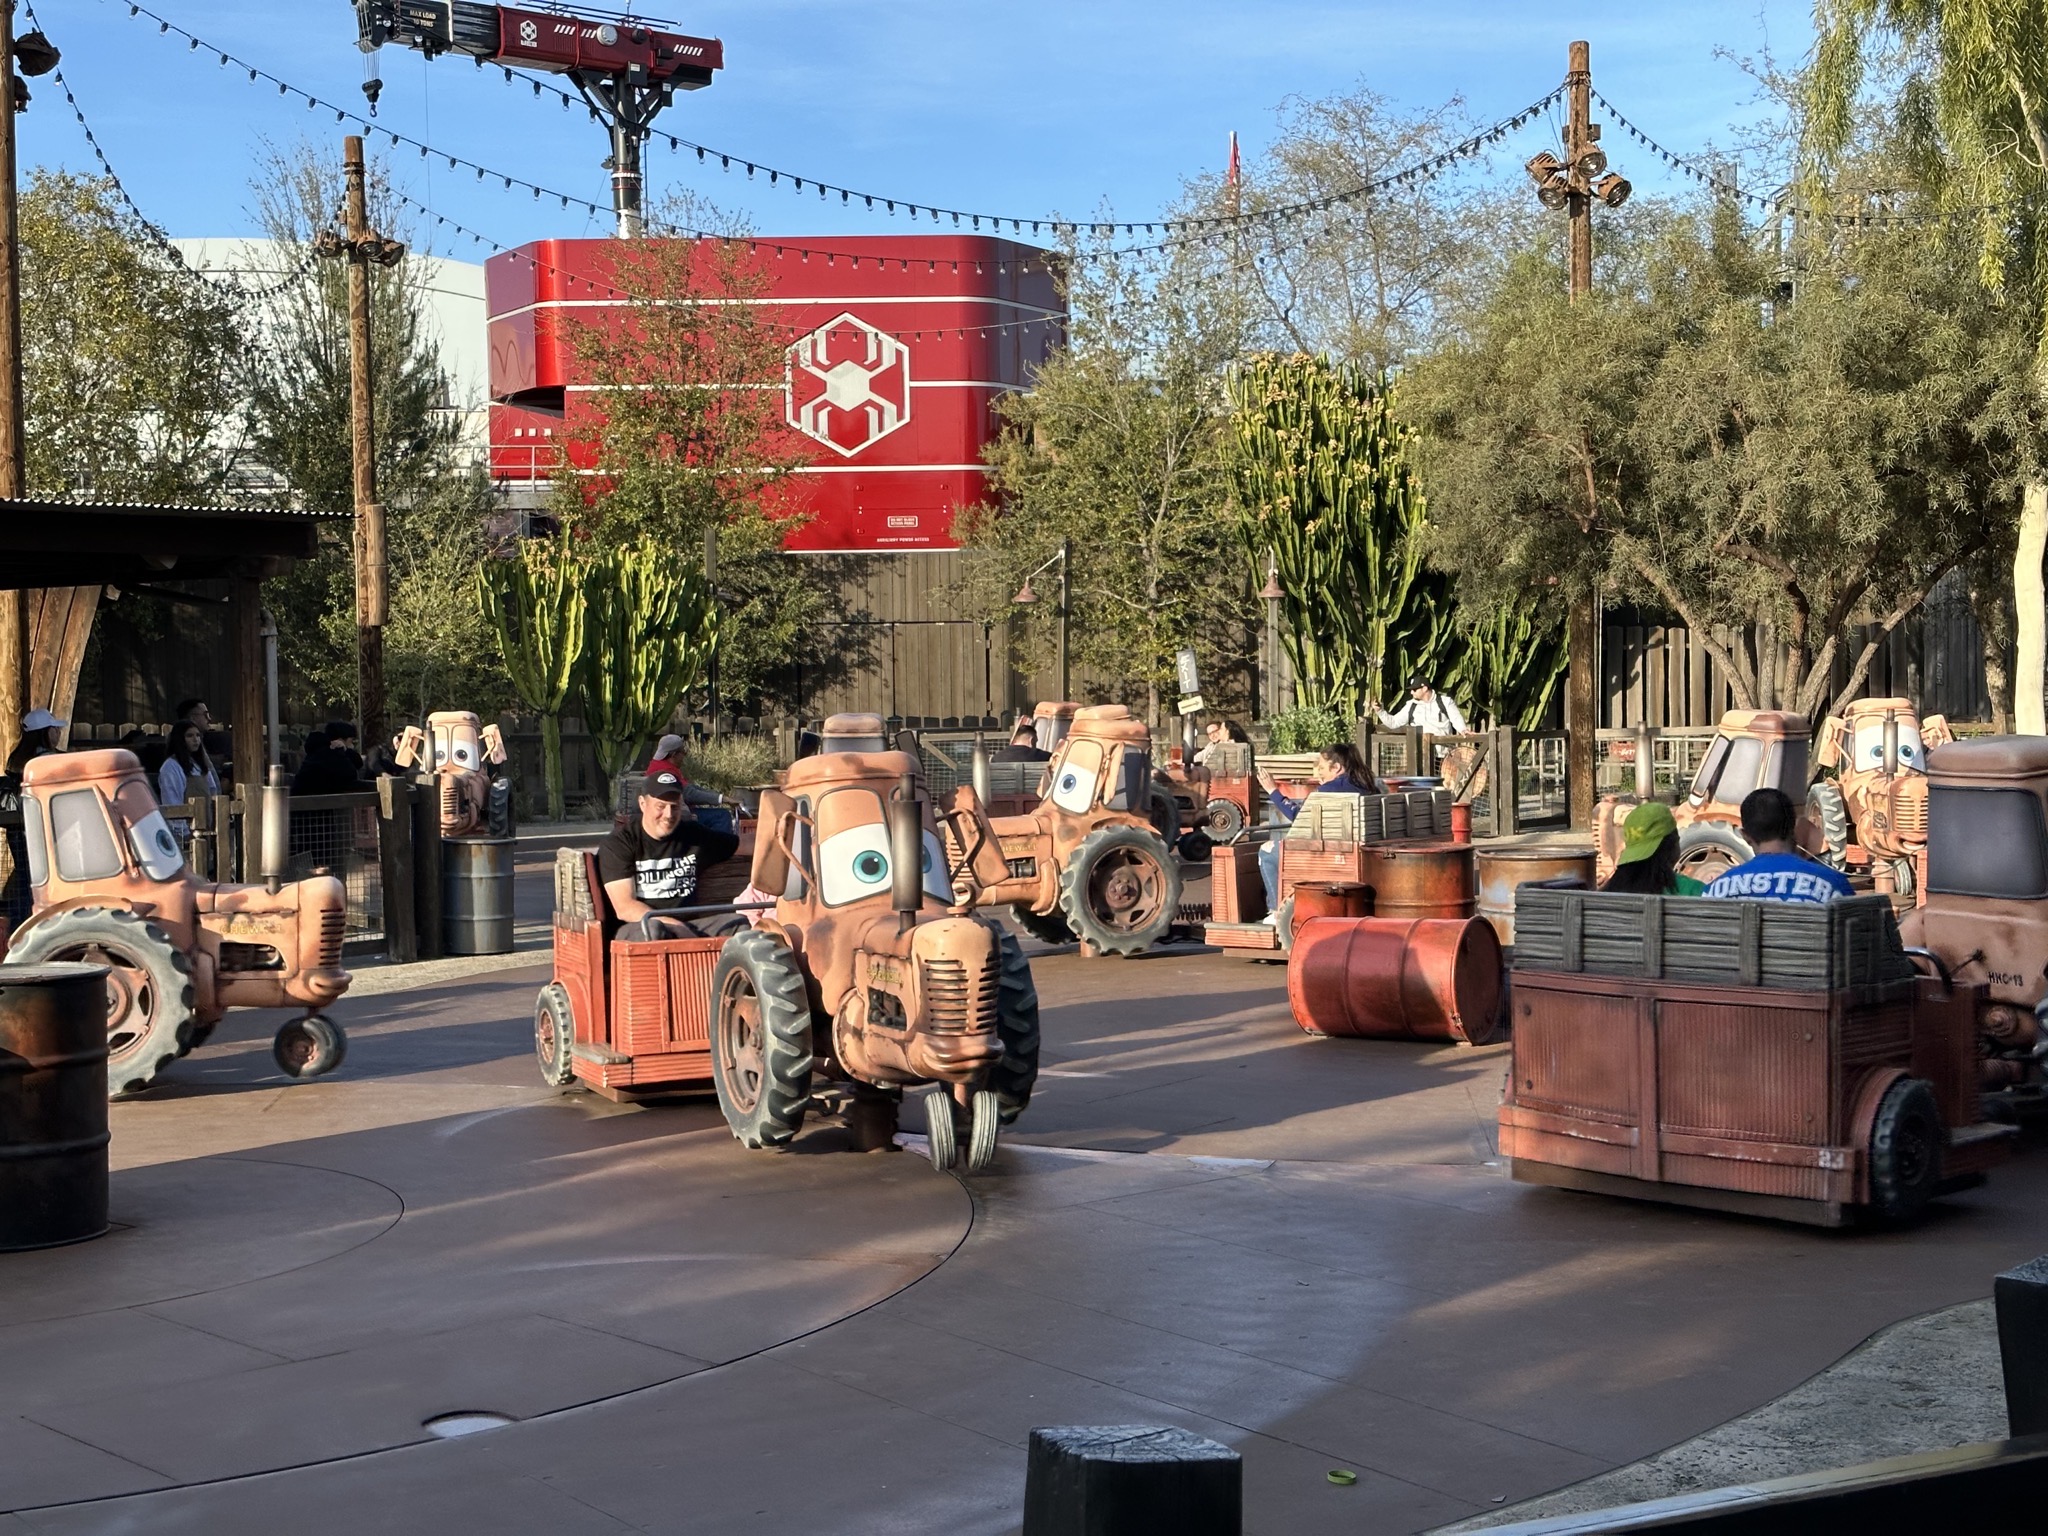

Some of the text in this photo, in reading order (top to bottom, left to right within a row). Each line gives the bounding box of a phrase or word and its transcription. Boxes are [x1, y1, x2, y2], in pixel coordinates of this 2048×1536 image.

[1180, 654, 1191, 689] EXIT
[673, 854, 696, 868] THE
[637, 865, 696, 884] DILLINGER
[1701, 871, 1844, 902] ONSTER
